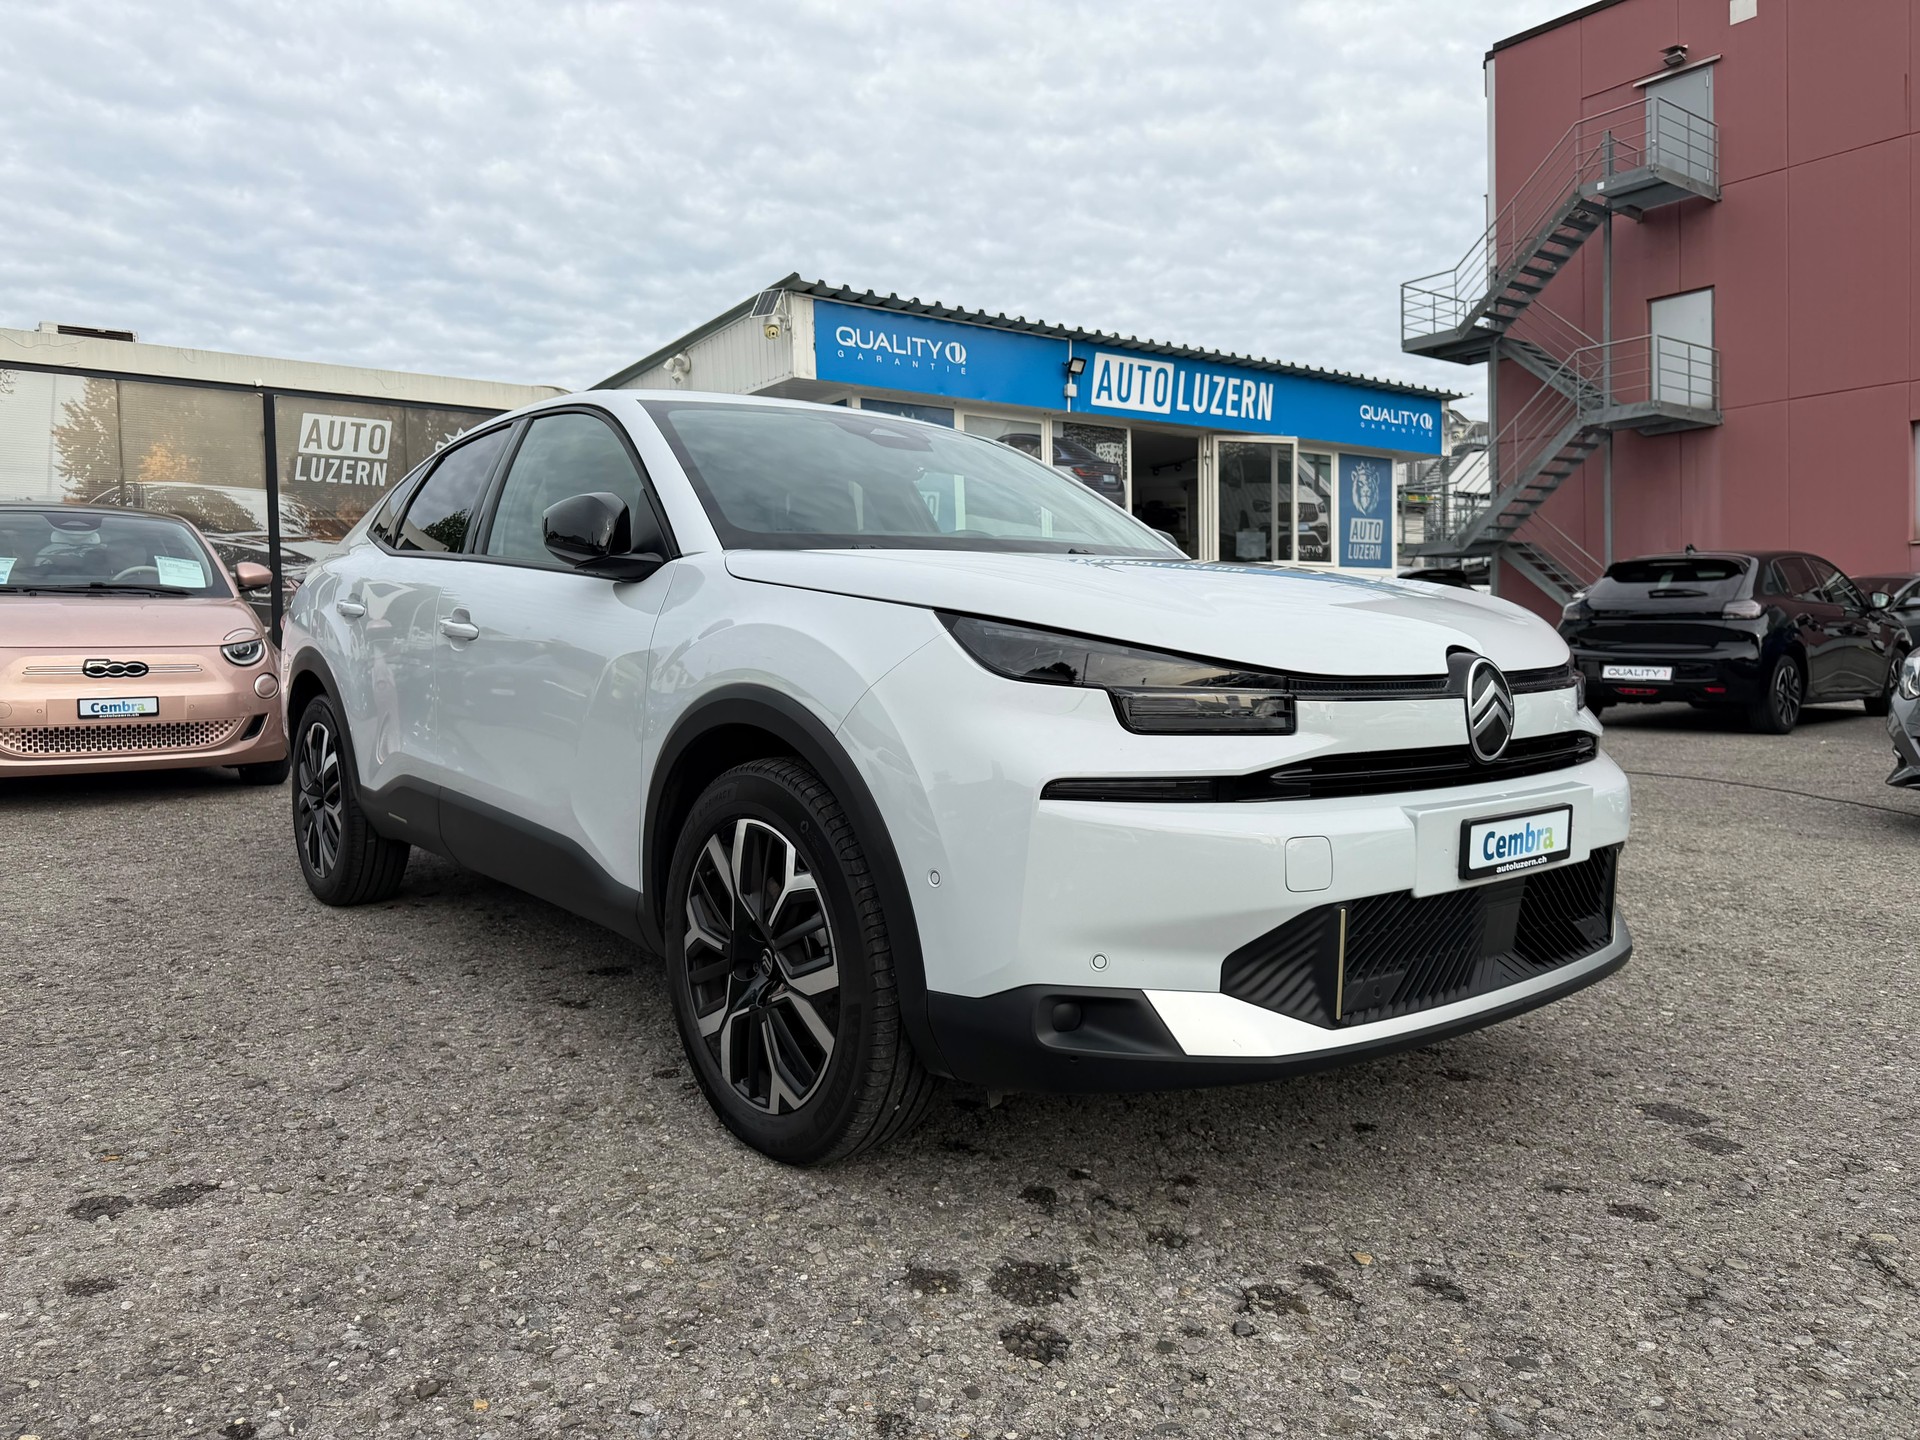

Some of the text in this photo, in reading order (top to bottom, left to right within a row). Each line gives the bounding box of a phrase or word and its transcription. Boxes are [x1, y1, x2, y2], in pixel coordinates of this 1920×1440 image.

[837, 349, 967, 375] GARANTIE
[302, 418, 387, 455] AUTO
[294, 455, 388, 487] LUZERN
[1350, 520, 1381, 541] AUTO
[1347, 543, 1382, 560] LUZERN
[84, 659, 148, 677] 500
[90, 700, 146, 713] Cembra
[1483, 822, 1554, 861] Cembra
[1496, 855, 1548, 873] autoluzern.ch
